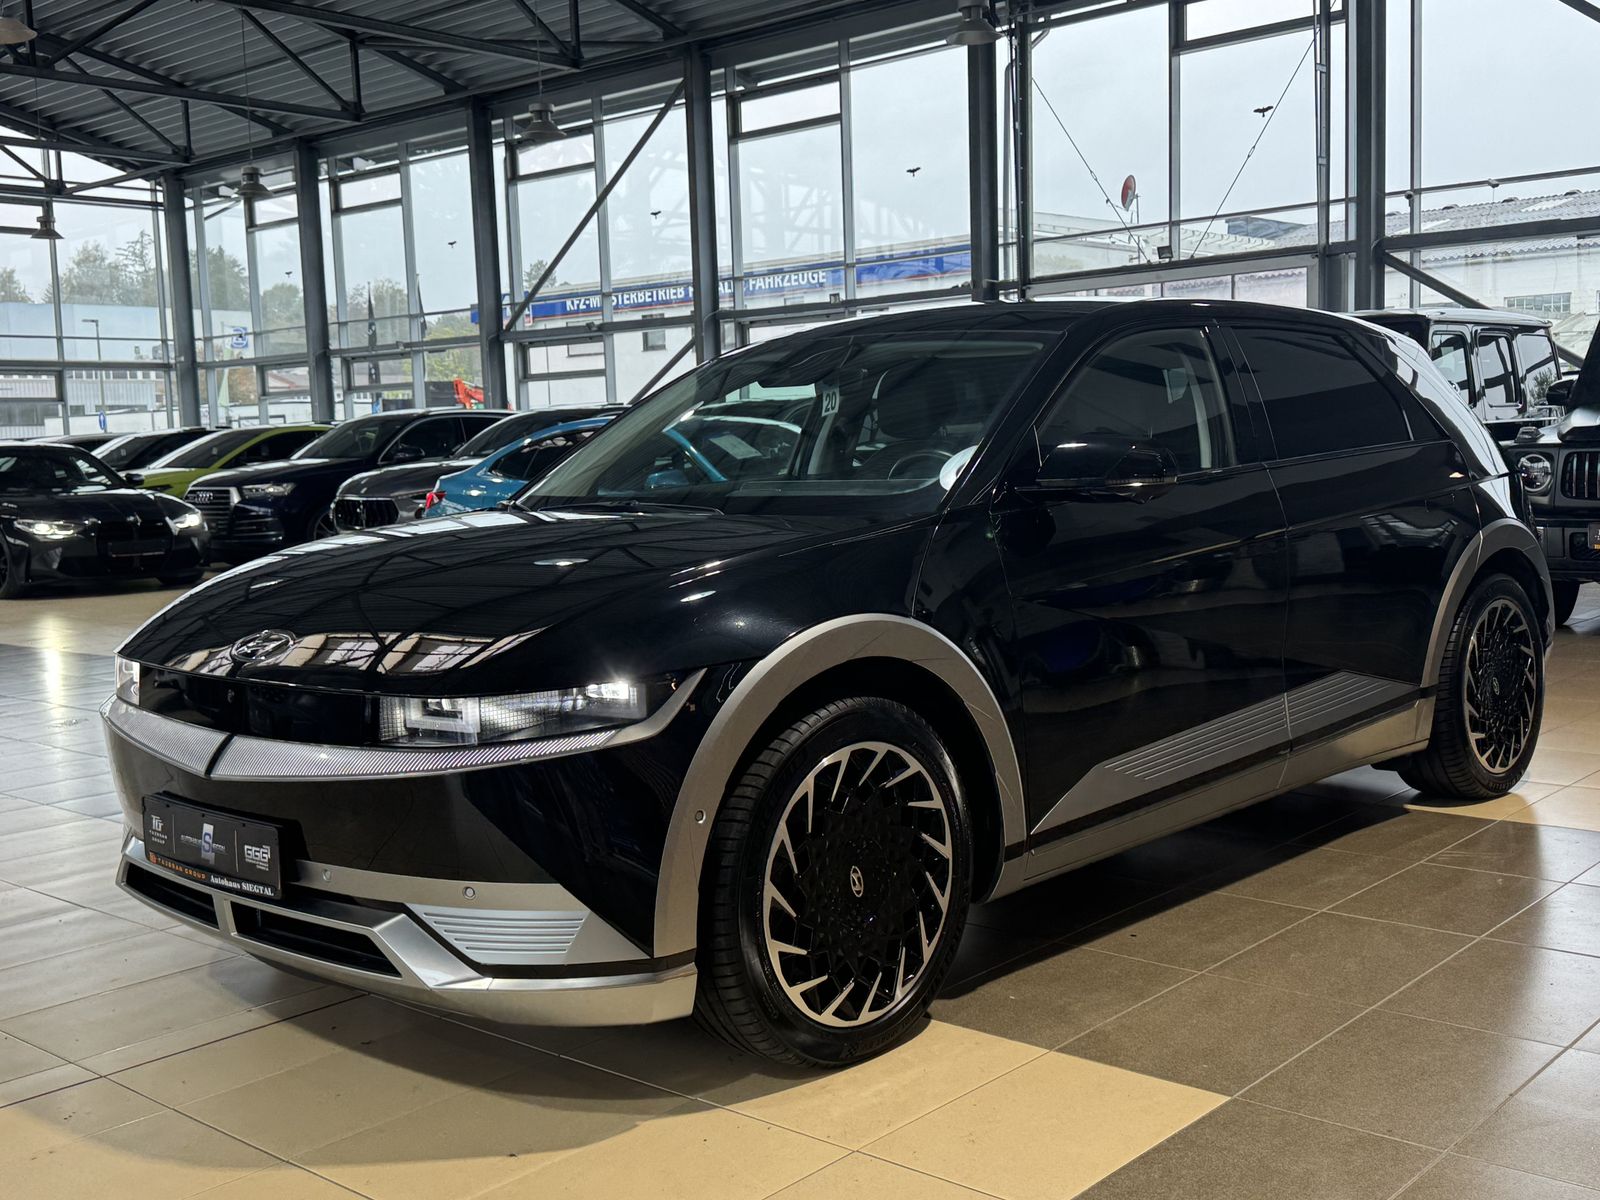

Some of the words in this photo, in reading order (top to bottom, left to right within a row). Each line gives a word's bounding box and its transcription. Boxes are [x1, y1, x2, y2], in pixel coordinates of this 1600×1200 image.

[566, 287, 685, 311] KFZ-MSTERBETRIEB
[749, 271, 826, 291] FAHRZEUGE
[824, 391, 837, 413] 20
[210, 875, 240, 889] Autohaus
[242, 882, 274, 896] SIEGTAL
